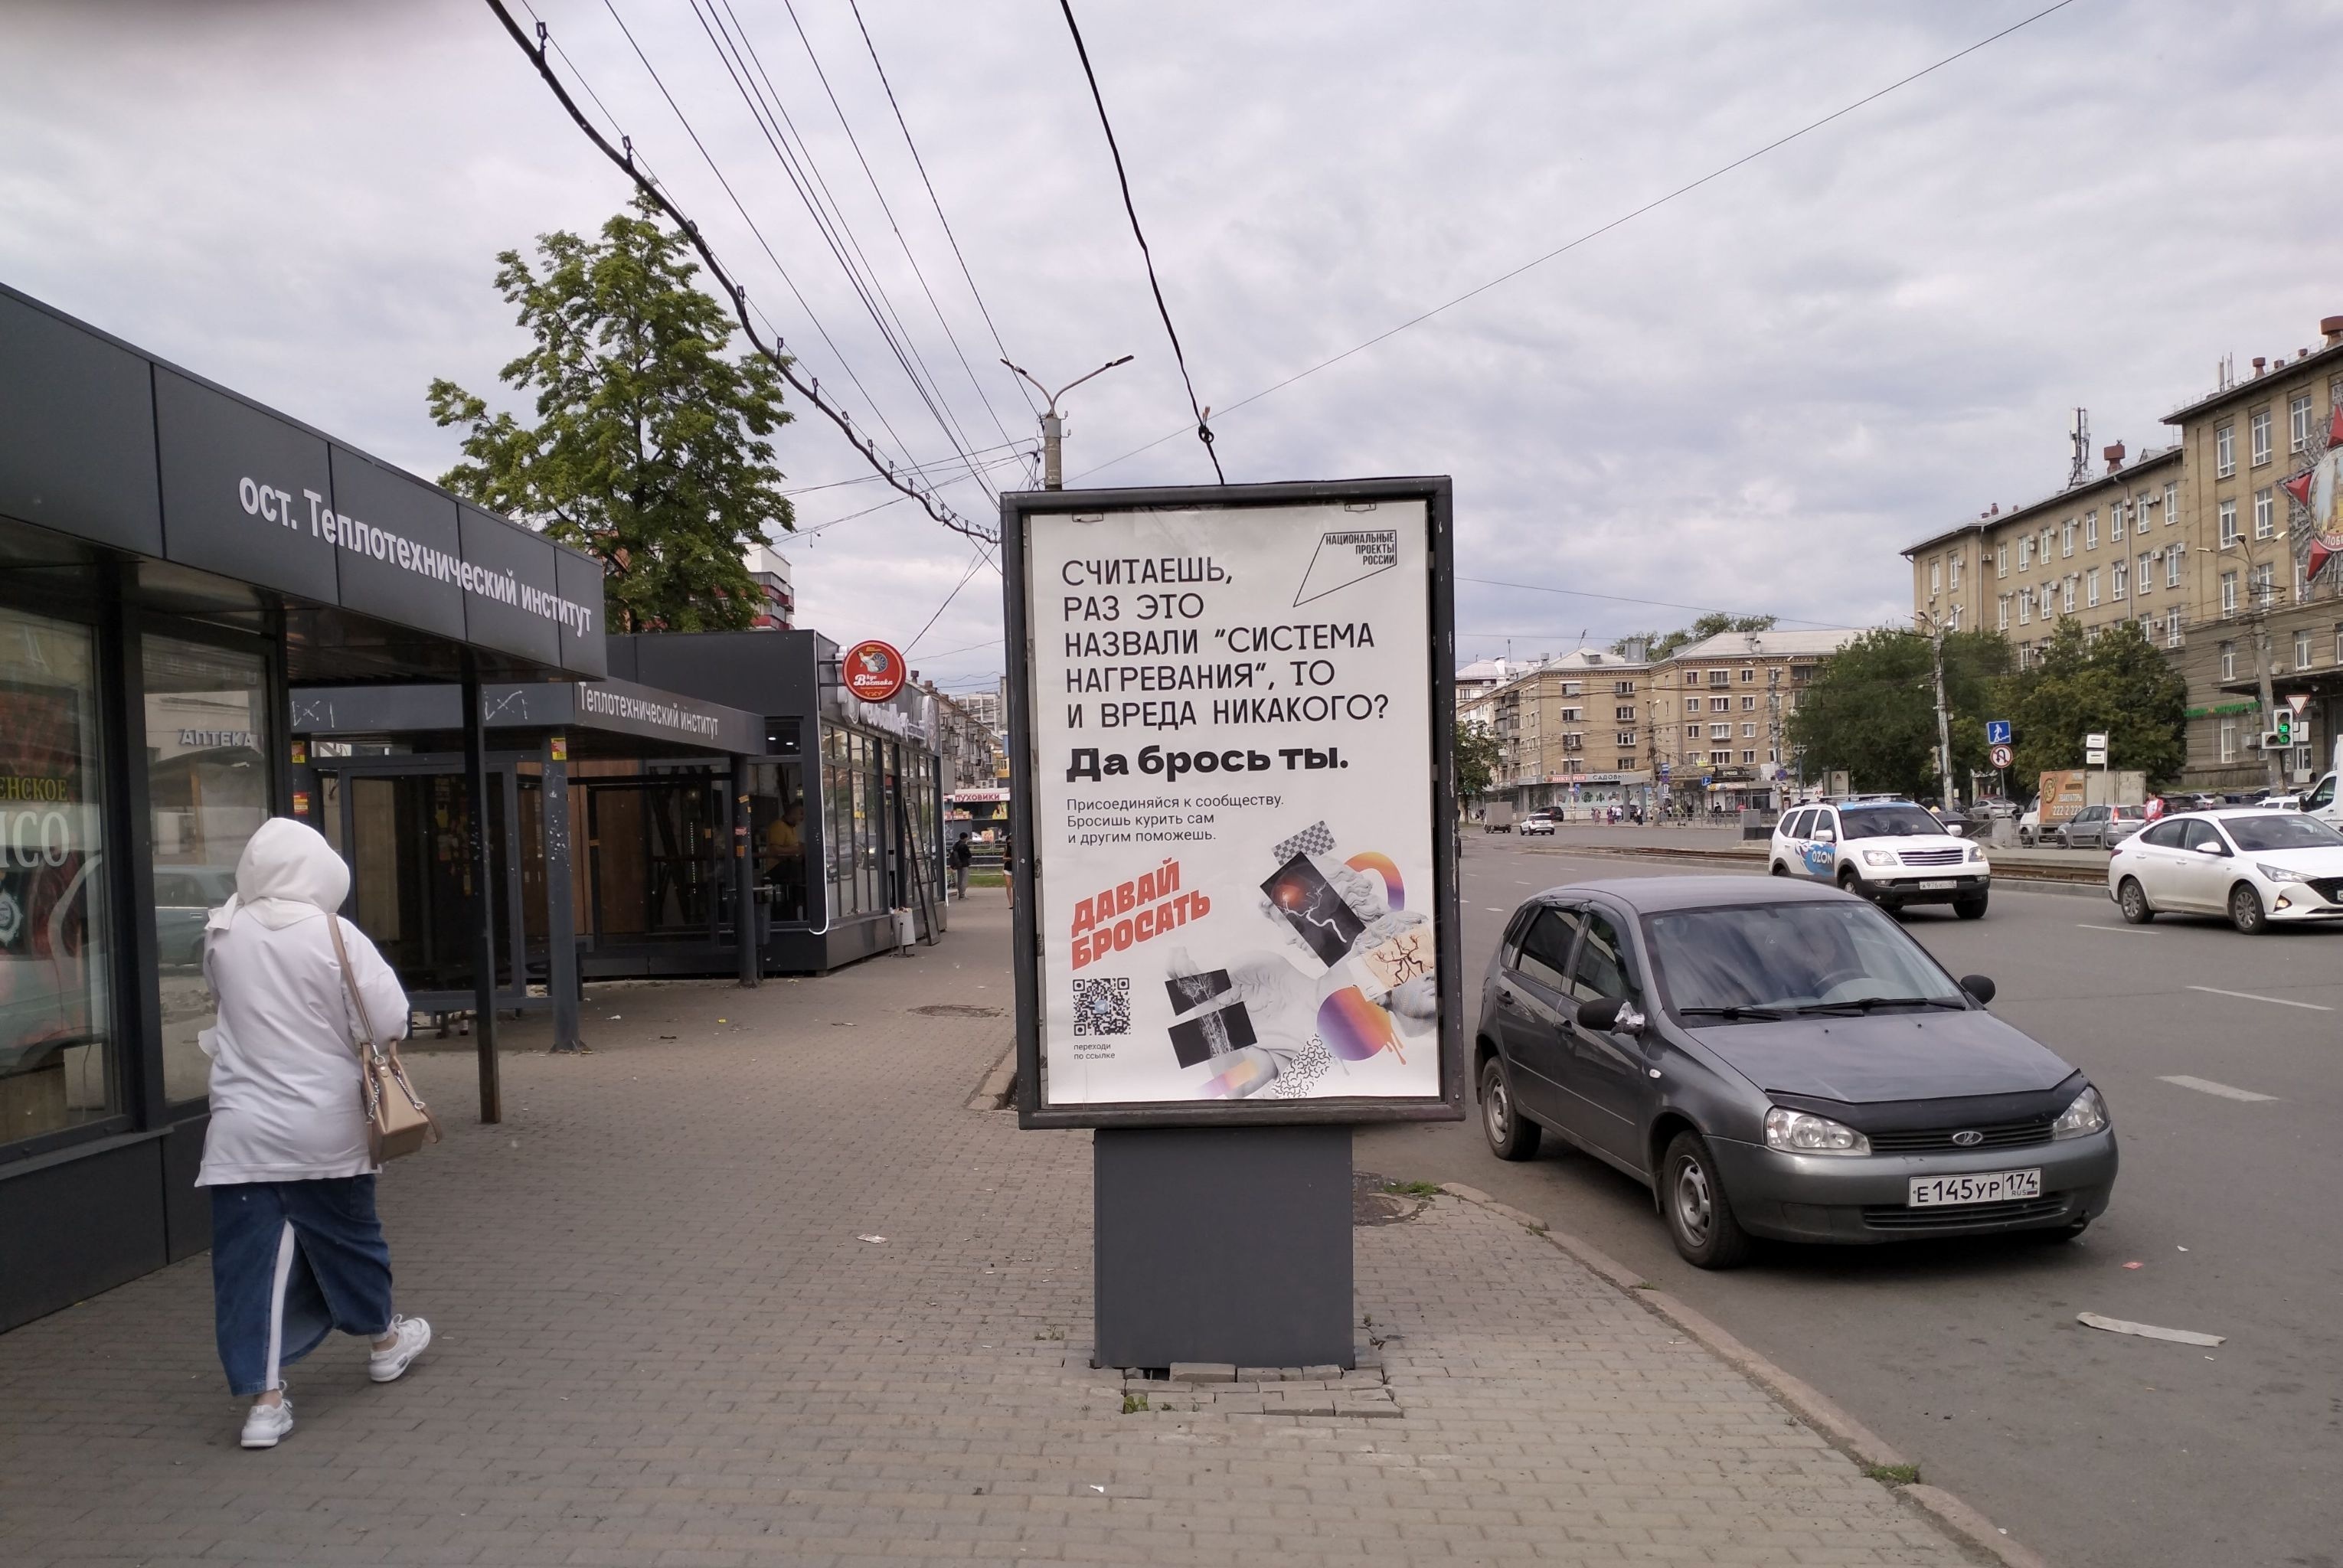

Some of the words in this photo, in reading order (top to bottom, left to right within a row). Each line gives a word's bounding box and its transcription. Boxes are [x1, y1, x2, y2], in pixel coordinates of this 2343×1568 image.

[1326, 534, 1394, 544] НАЦИОНАЛЬНЫЕ
[1356, 544, 1394, 554] ПРОЕКТЫ
[303, 488, 517, 606] Теплотехнический
[521, 583, 591, 638] институт
[1063, 557, 1232, 586] СЧИТАЕШЬ,
[1363, 554, 1394, 565] РОССИИ
[1064, 596, 1119, 621] РАЗ
[1137, 593, 1204, 619] ЭТО
[1066, 629, 1198, 657] НАЗВАЛИ
[1290, 660, 1335, 685] ТО
[578, 681, 679, 729] Теплотехнический
[681, 712, 719, 740] институт
[1068, 704, 1082, 728] И
[1102, 701, 1196, 730] ВРЕДА
[1214, 694, 1388, 724] НИКАКОГО?
[1067, 748, 1129, 782] Да
[1139, 745, 1270, 782] брось
[1279, 747, 1348, 769] ты.
[955, 793, 1000, 802] ПУХОВИКИ
[1067, 797, 1178, 813] Присоединяйся
[1185, 799, 1191, 807] к
[1196, 794, 1283, 808] сообществу.
[1068, 814, 1131, 829] Бросишь
[1136, 814, 1183, 828] курить
[1188, 813, 1214, 824] сам
[1068, 833, 1077, 844] и
[1080, 832, 1132, 847] другим
[1136, 830, 1217, 842] поможешь.
[1812, 851, 1833, 864] OZON
[1072, 858, 1180, 939] ДАВАЙ
[1072, 889, 1211, 971] БРОСАТЬ
[1917, 1178, 2000, 1203] Е145УР
[2005, 1173, 2034, 1190] 174
